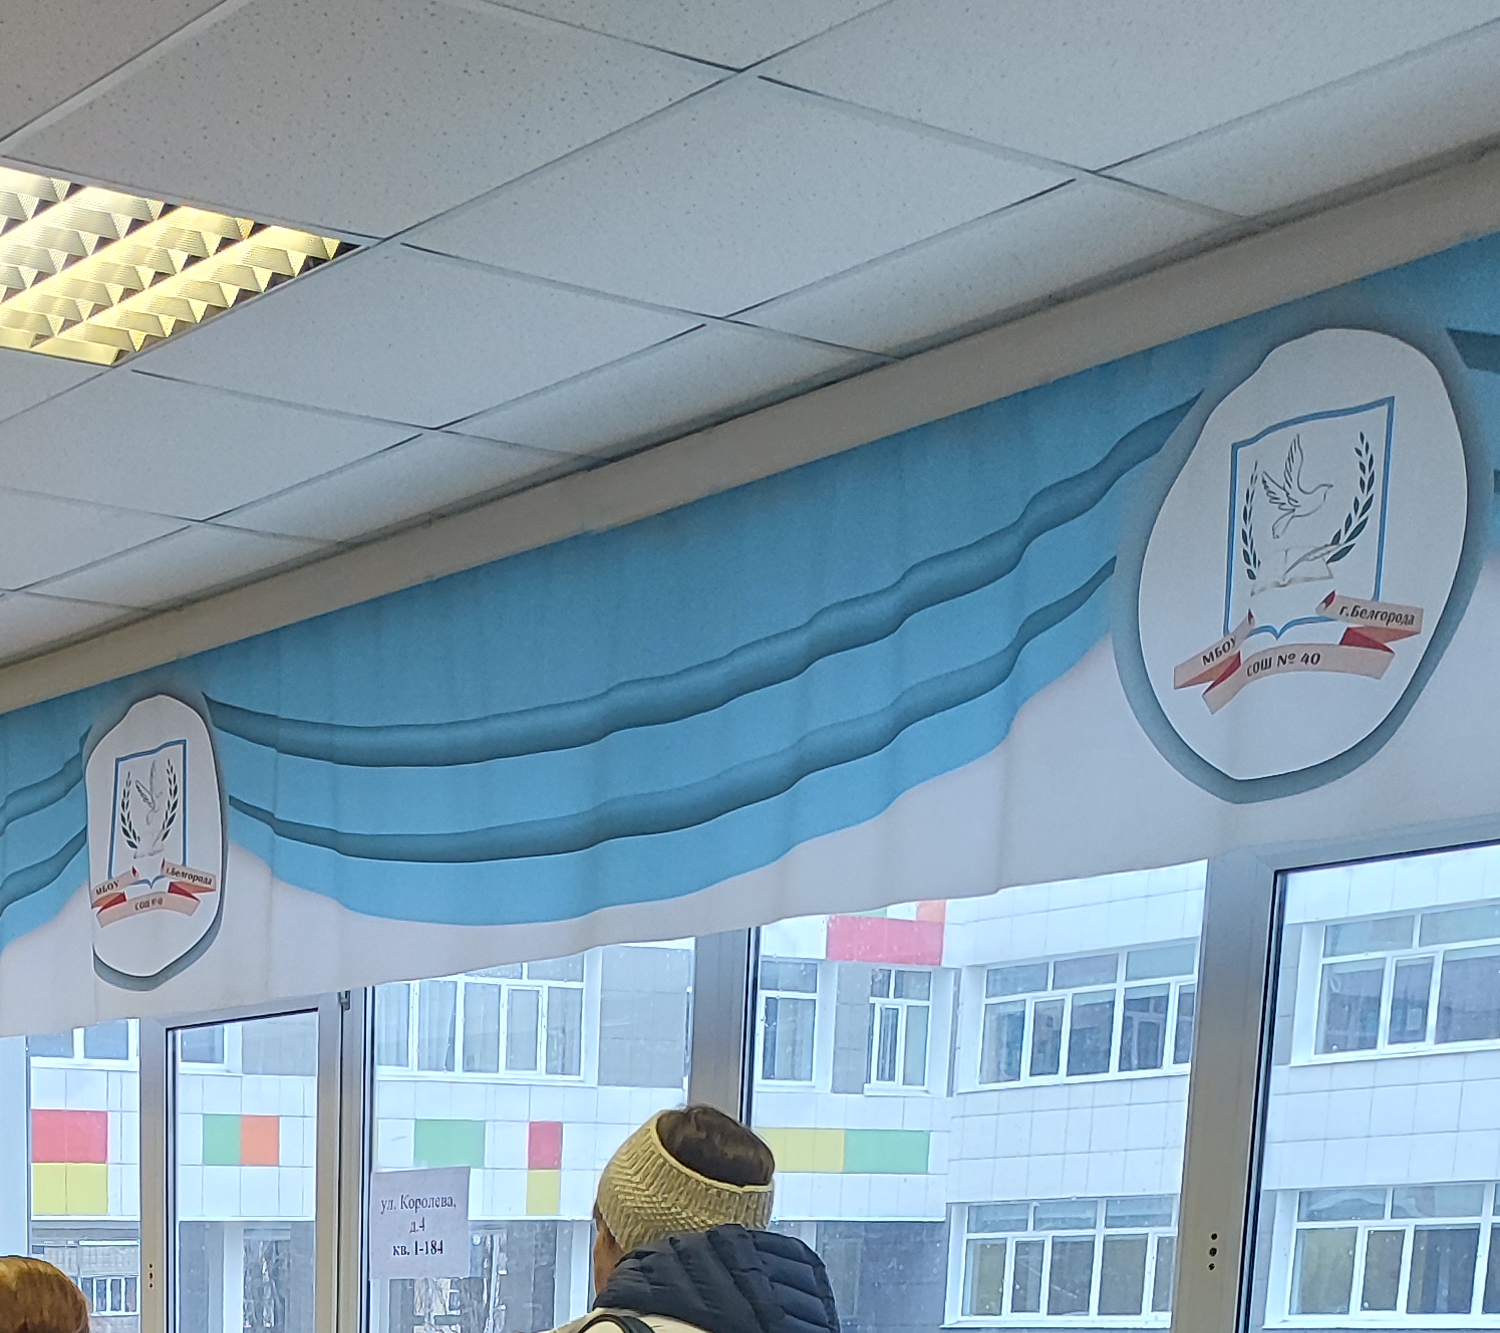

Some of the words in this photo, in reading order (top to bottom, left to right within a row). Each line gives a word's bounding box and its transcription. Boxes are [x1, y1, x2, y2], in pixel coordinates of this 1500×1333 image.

[1338, 604, 1415, 626] г.Белгорода
[1202, 635, 1237, 667] МБОУ
[1246, 657, 1273, 678] СОШ
[1300, 652, 1322, 666] 40
[380, 1199, 397, 1215] ул.
[400, 1194, 457, 1214] Королева,
[409, 1216, 426, 1234] д.4
[392, 1245, 411, 1256] кв.
[414, 1239, 444, 1256] 1-184
